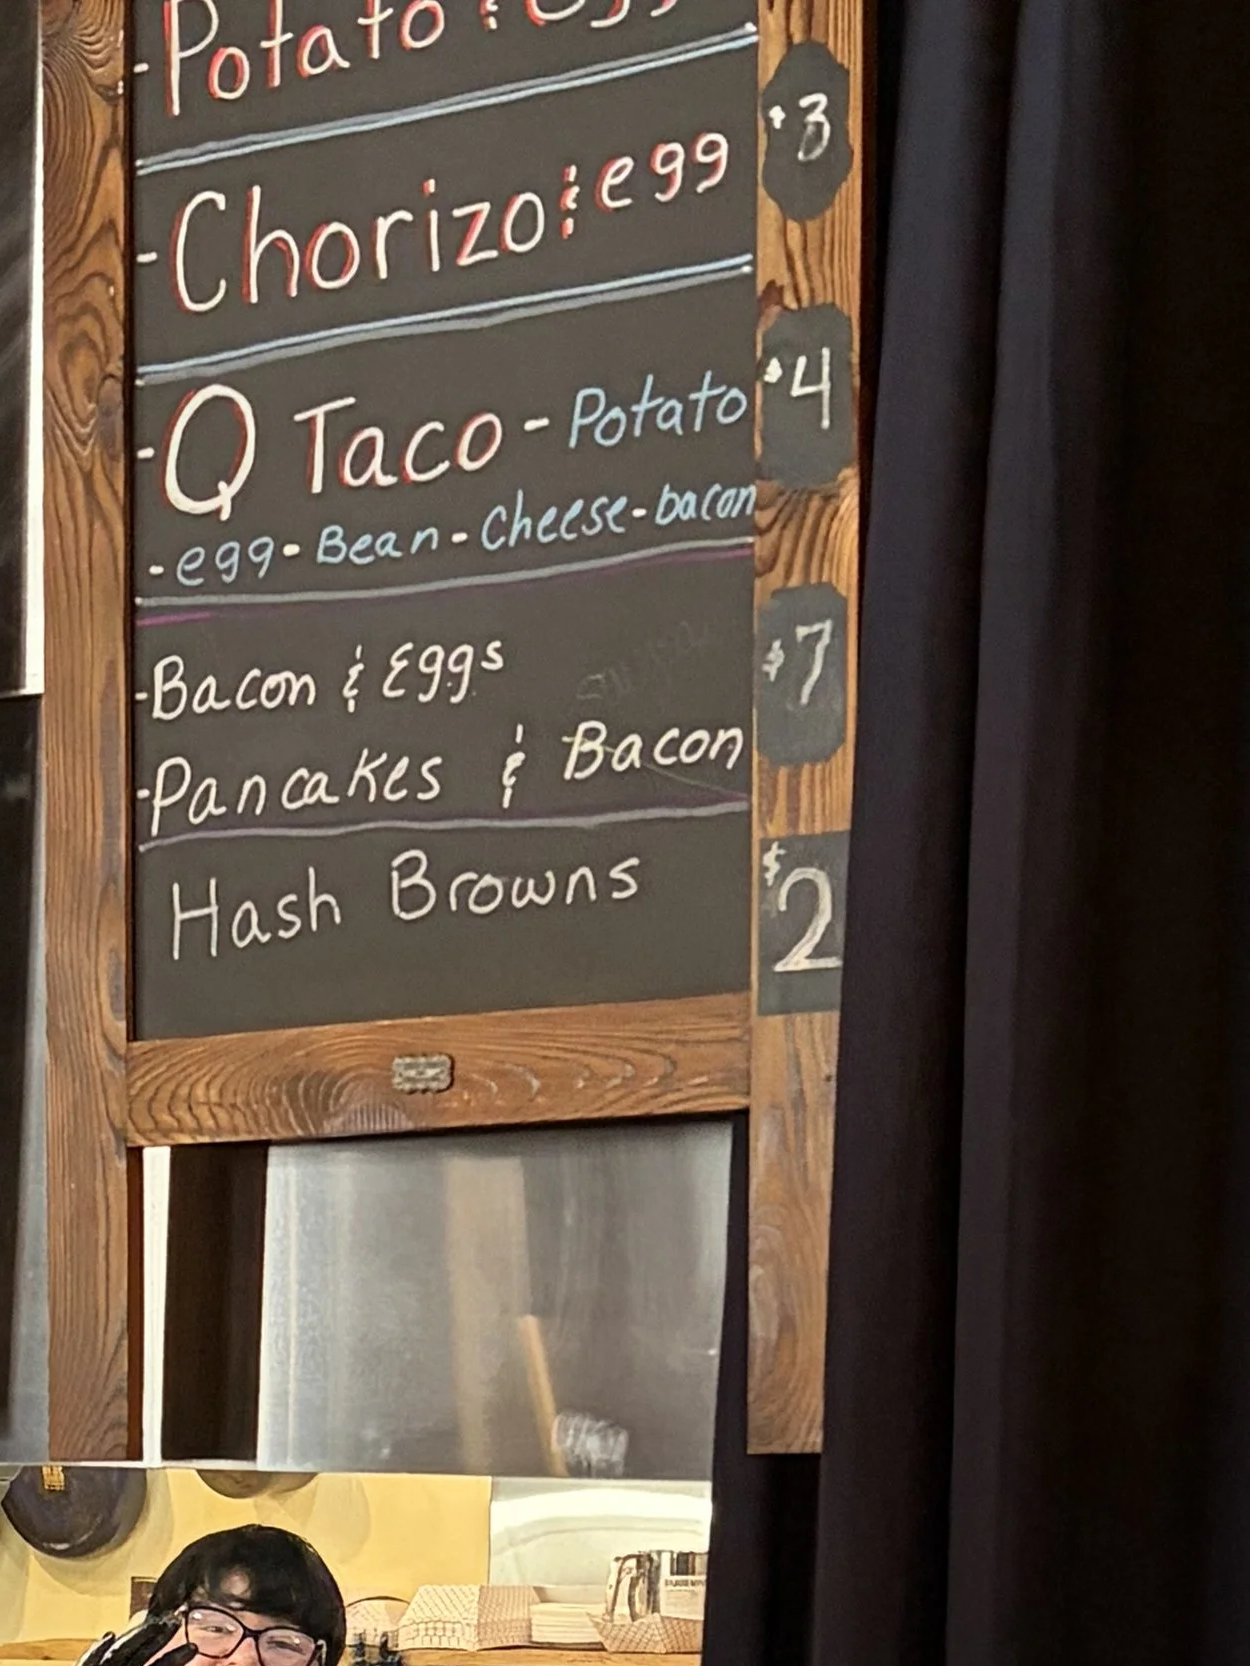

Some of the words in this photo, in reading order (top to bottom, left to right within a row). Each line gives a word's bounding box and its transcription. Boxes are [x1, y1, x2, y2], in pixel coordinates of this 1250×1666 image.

[597, 133, 728, 208] egg
[294, 397, 502, 493] Taco
[569, 370, 747, 448] Potato
[317, 525, 438, 564] Bean
[383, 640, 503, 703] Eggs
[762, 618, 833, 704] $7
[562, 720, 743, 780] Bacon
[173, 866, 341, 960] Hash
[391, 849, 640, 920] Browns
[762, 841, 842, 972] $2
